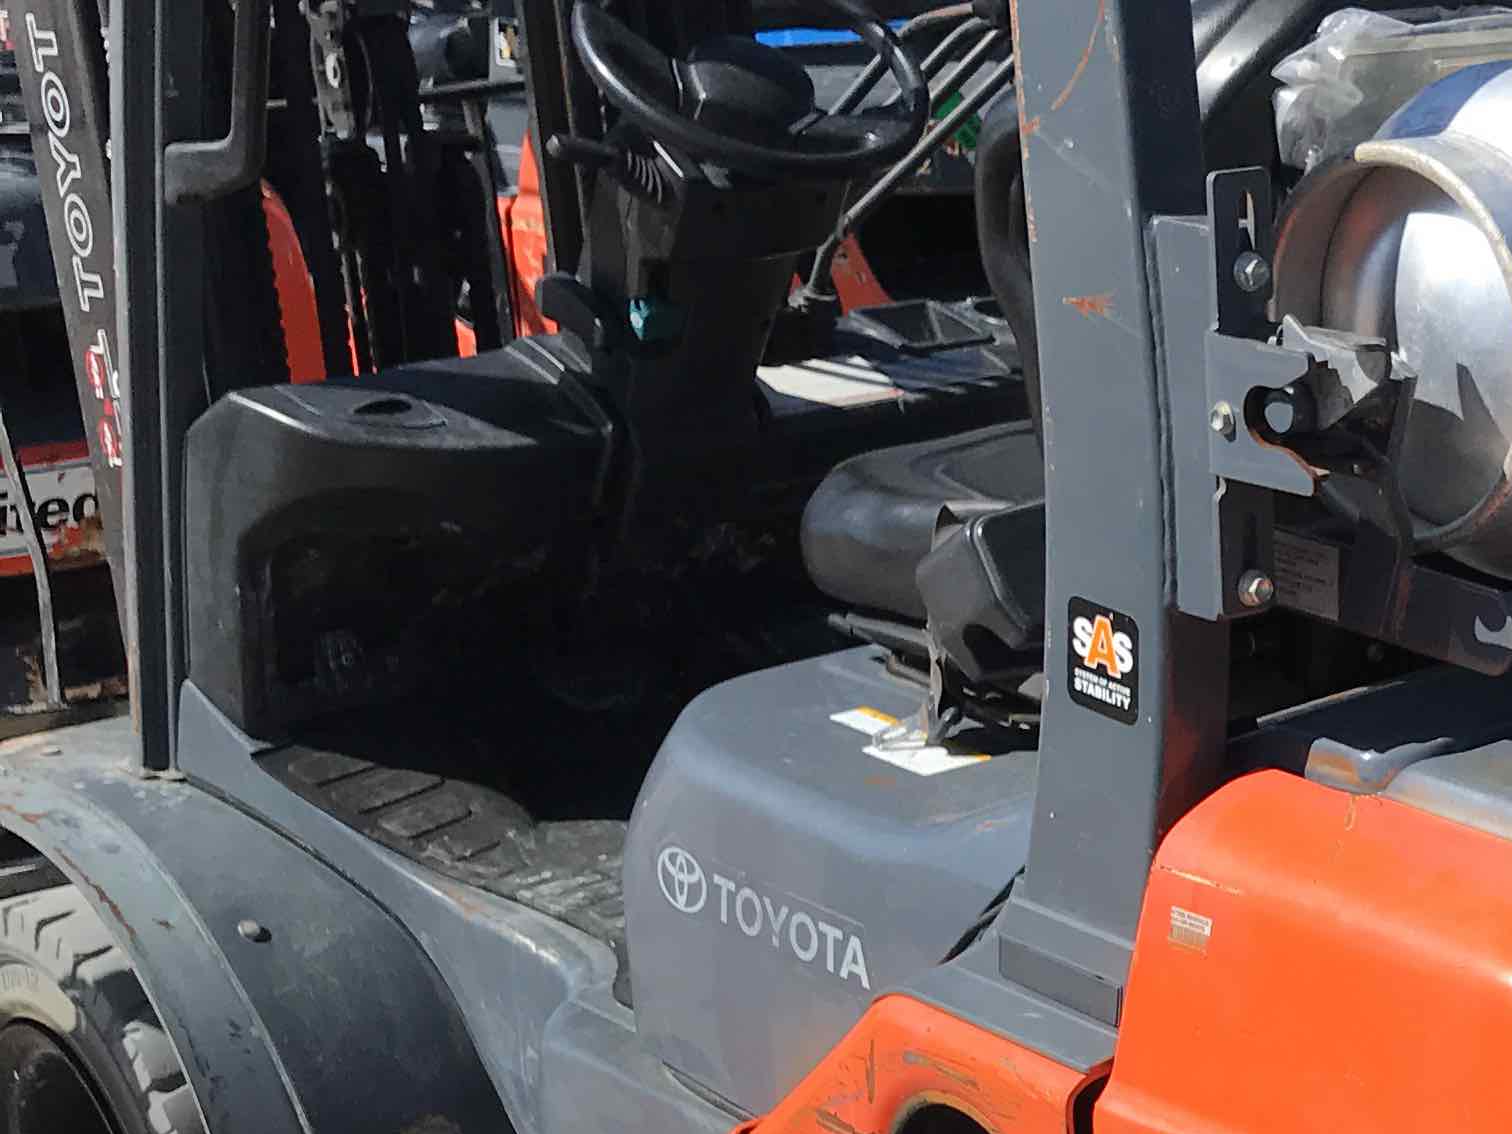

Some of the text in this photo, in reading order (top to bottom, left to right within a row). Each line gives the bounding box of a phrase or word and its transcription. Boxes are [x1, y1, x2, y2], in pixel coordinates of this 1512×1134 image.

[25, 11, 104, 312] TOYOT
[1072, 613, 1133, 679] SAS
[1073, 676, 1131, 710] STABILITY
[712, 873, 871, 991] TOYOTA
